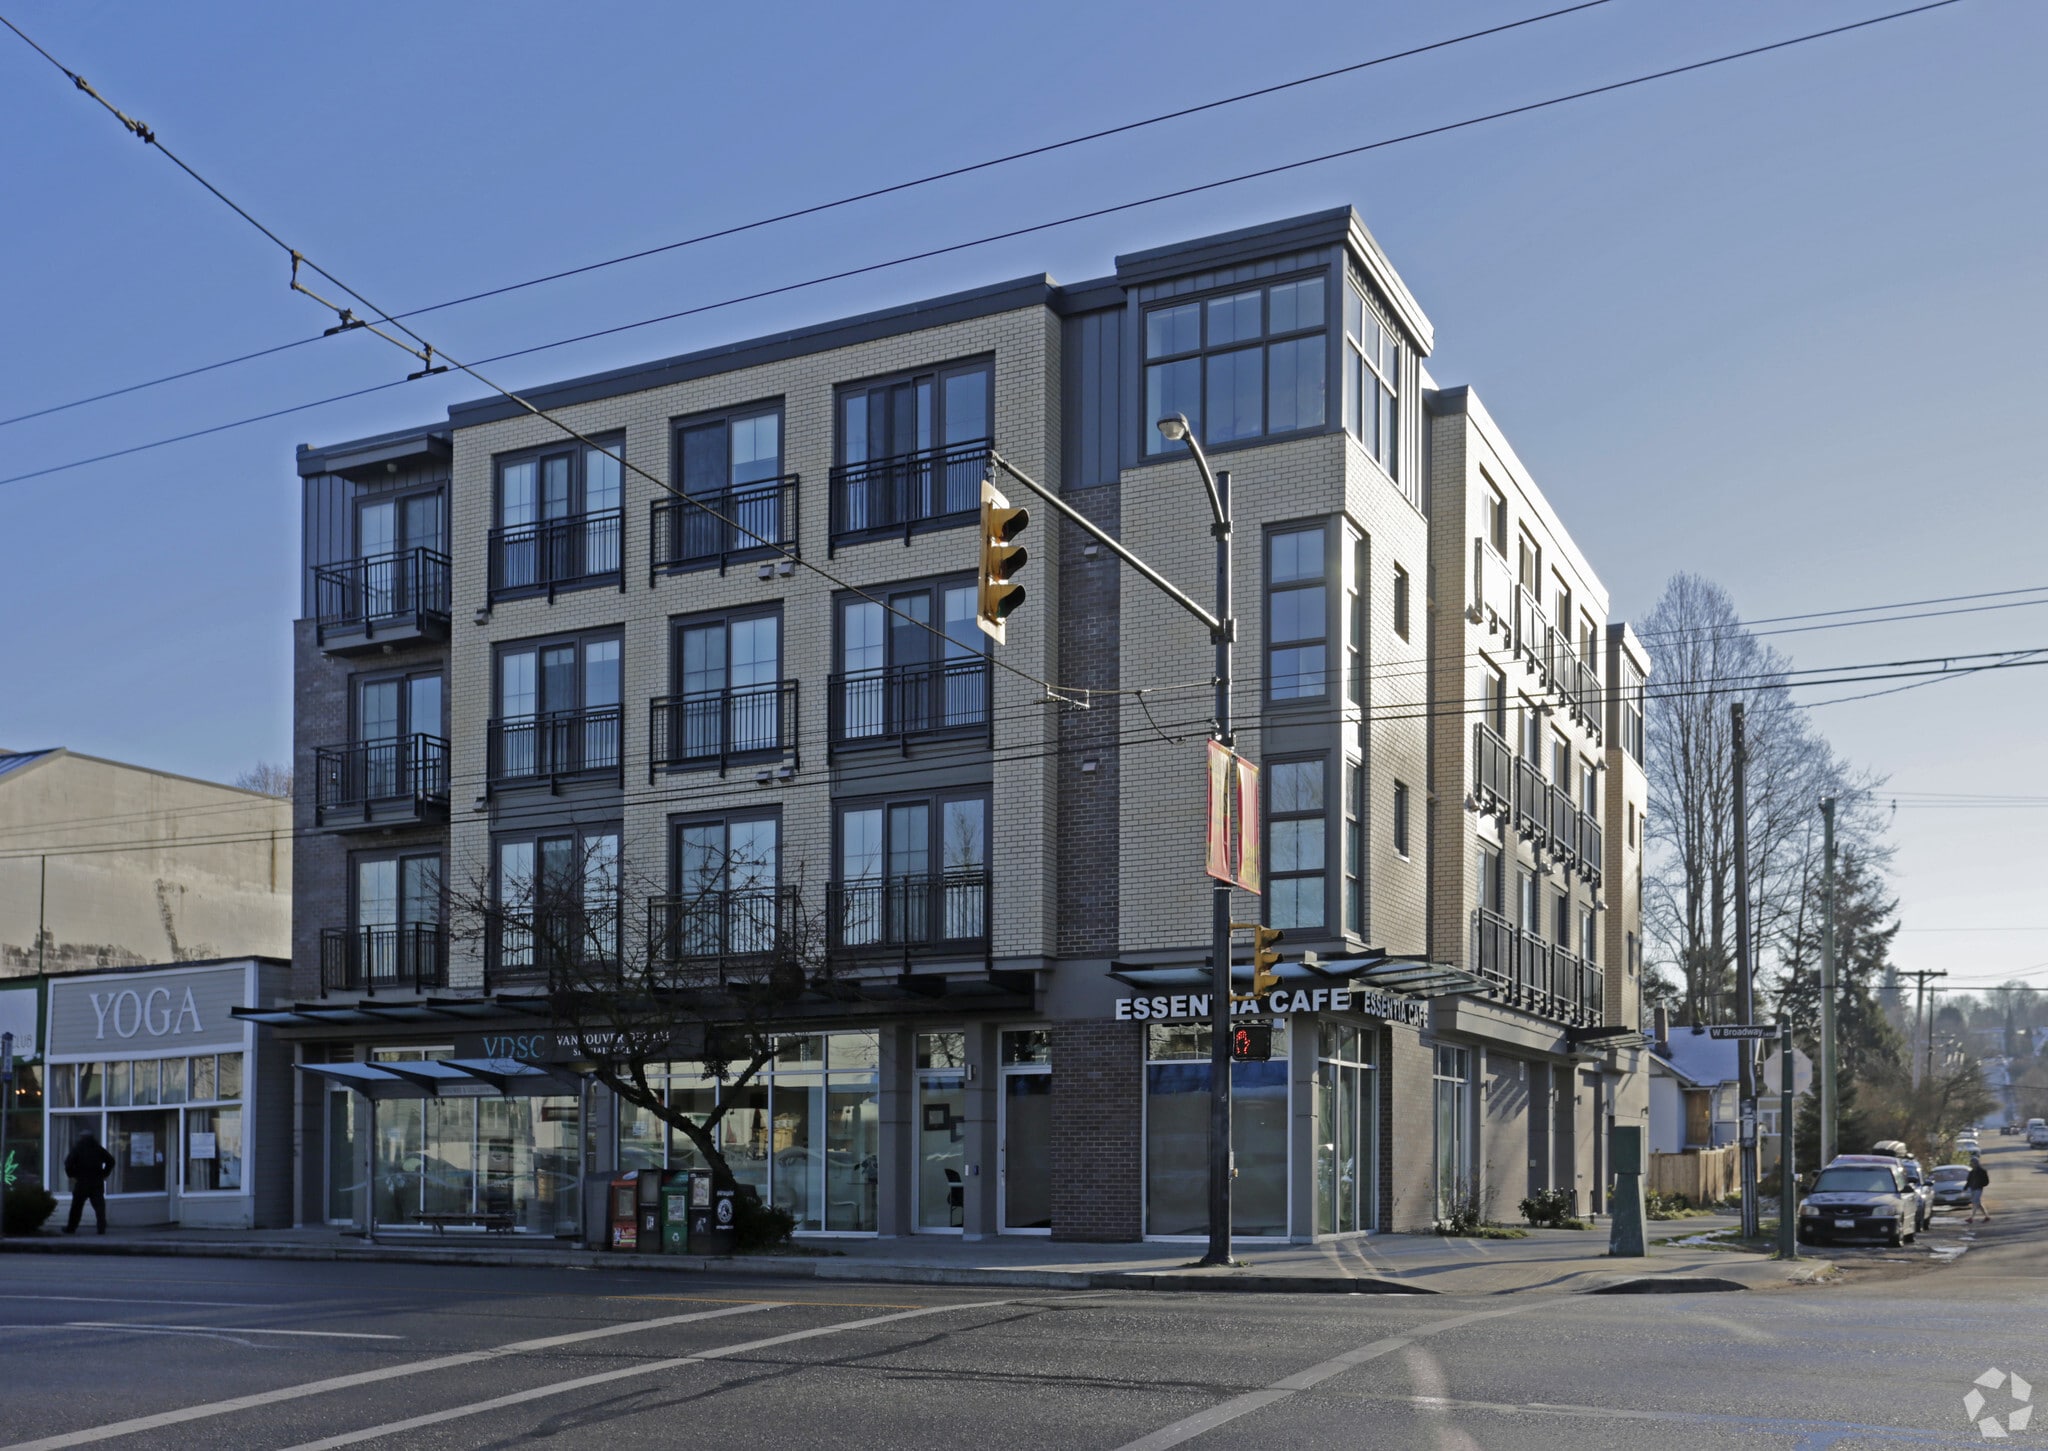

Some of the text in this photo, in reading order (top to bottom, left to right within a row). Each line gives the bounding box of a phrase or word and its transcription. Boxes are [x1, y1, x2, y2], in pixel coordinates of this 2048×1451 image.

[89, 985, 204, 1040] YOGA
[1115, 987, 1351, 1021] ESSENIA CAFE
[1364, 991, 1429, 1029] ESSENTIA CAFE
[482, 1034, 545, 1059] VDSC
[556, 1032, 625, 1046] VANOUVER
[1712, 1028, 1721, 1037] W
[1723, 1027, 1763, 1038] Broadway
